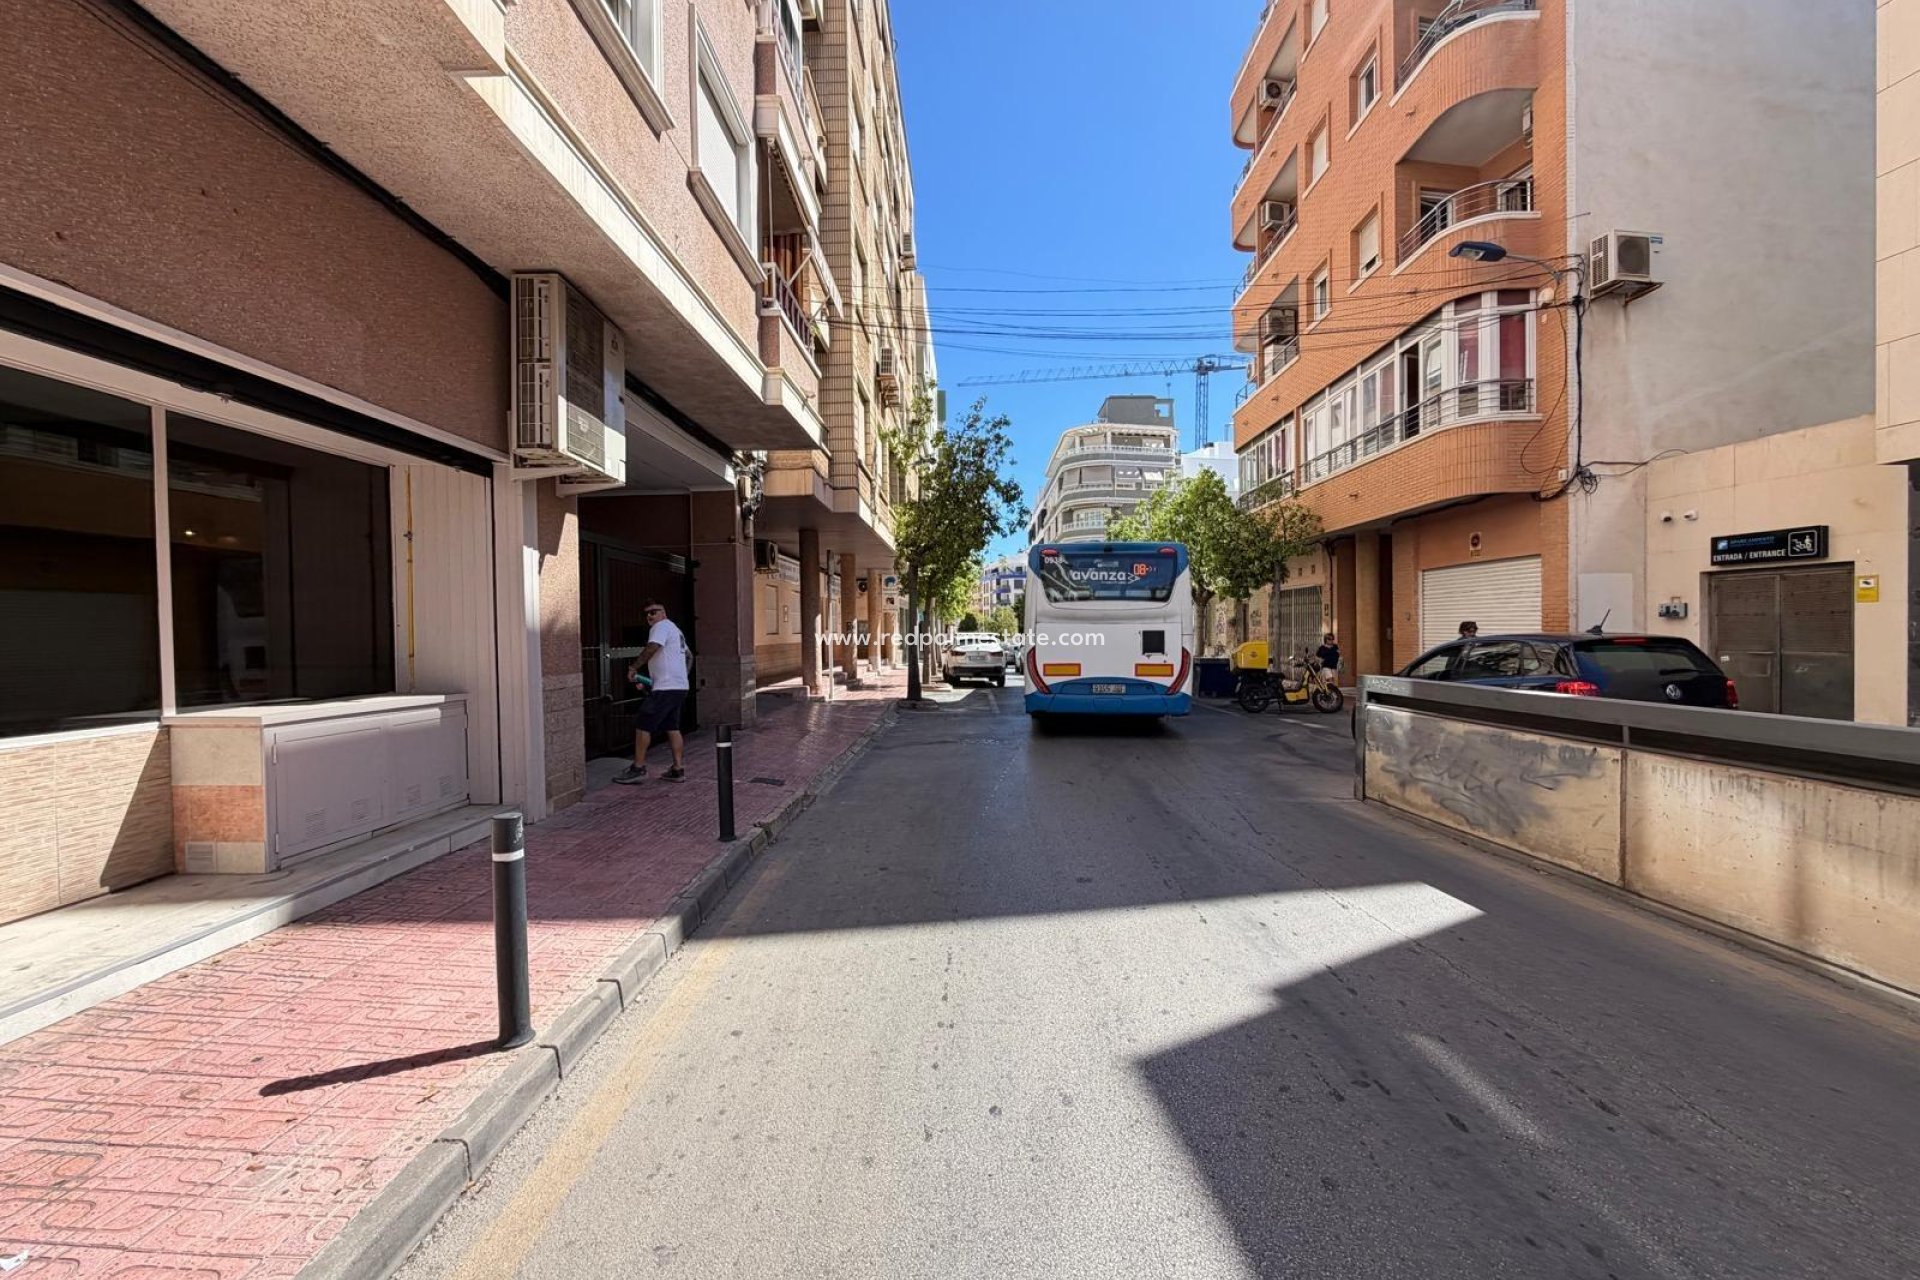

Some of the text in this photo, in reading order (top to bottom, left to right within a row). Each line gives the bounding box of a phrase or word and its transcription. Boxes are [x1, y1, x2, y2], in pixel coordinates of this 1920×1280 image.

[1713, 552, 1742, 562] ENTRADA
[1749, 549, 1786, 559] ENTRANCE
[1072, 570, 1126, 581] avanza
